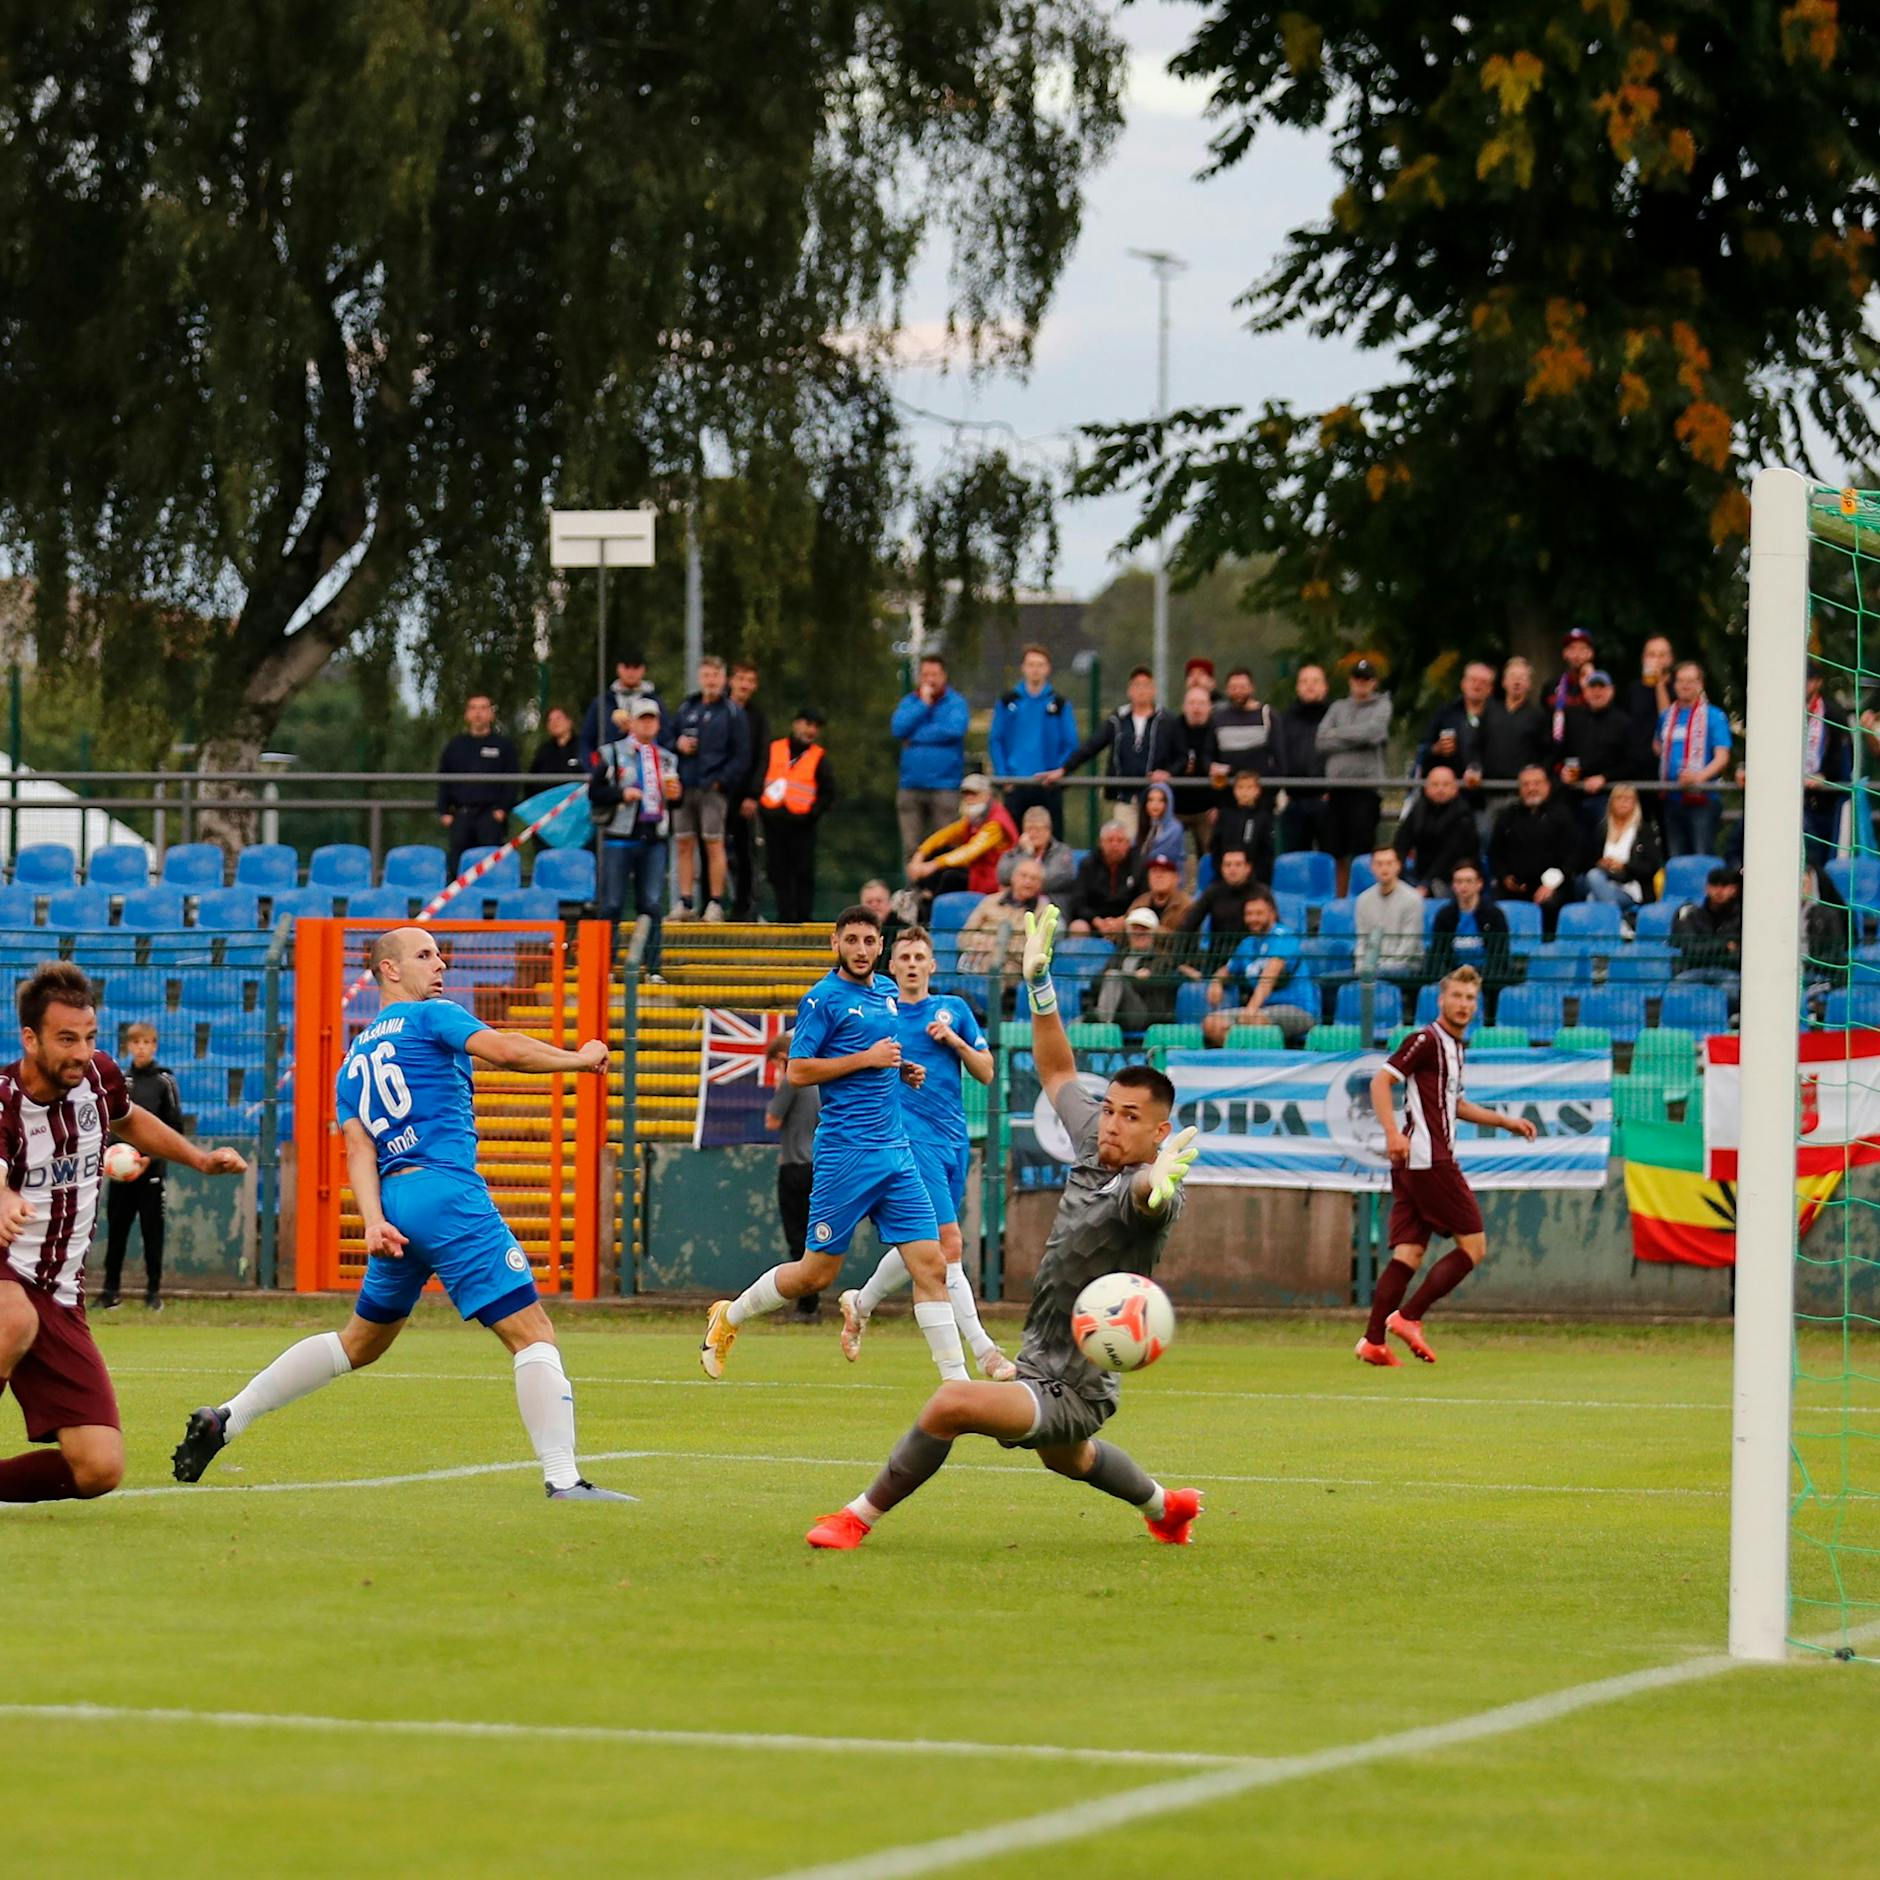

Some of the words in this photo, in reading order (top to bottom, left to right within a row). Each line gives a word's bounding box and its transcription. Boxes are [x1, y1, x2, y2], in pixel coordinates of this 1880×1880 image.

[359, 1017, 404, 1044] TASMANIA
[348, 1041, 412, 1137] 26
[1178, 1101, 1310, 1135] OPA
[1104, 1343, 1123, 1366] JAKO
